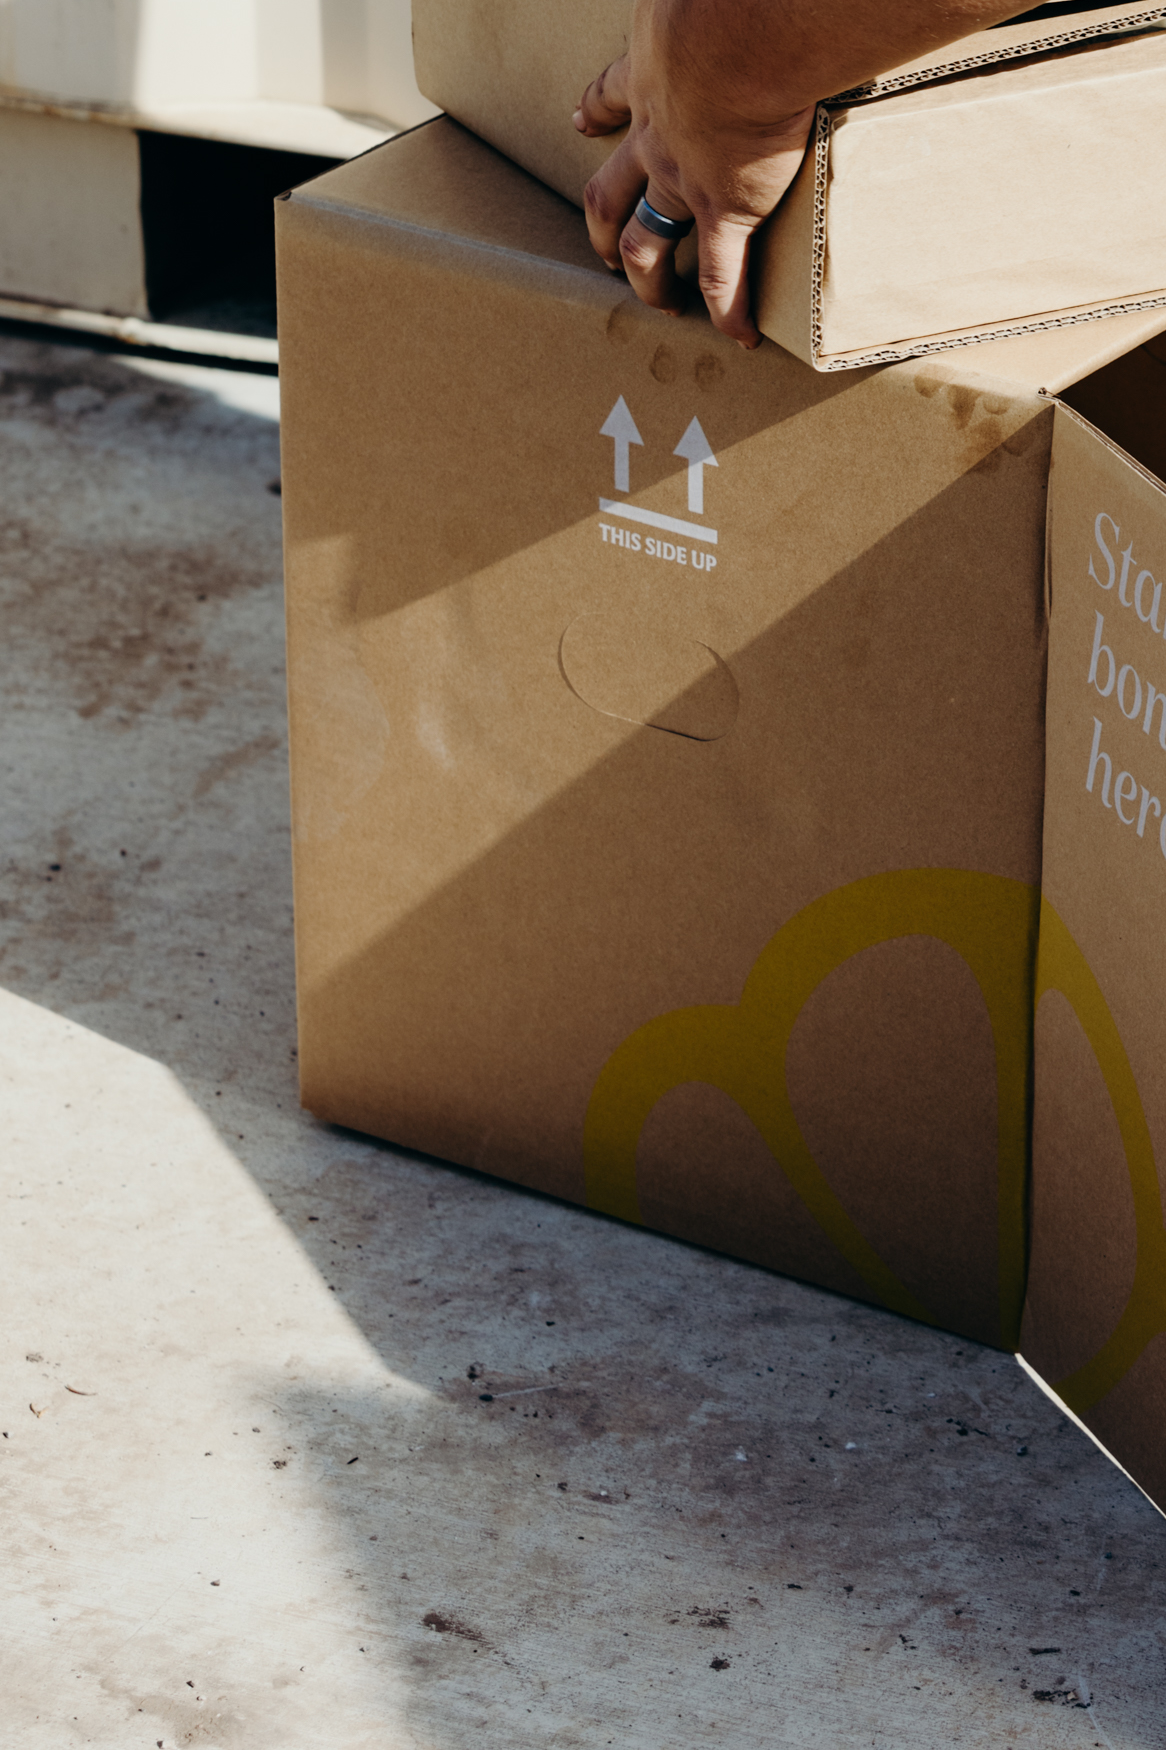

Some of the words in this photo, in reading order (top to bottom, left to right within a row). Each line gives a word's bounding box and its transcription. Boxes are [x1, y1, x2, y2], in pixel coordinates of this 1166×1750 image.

[598, 522, 642, 552] THIS
[644, 536, 688, 566] SIDE
[690, 549, 718, 572] UP
